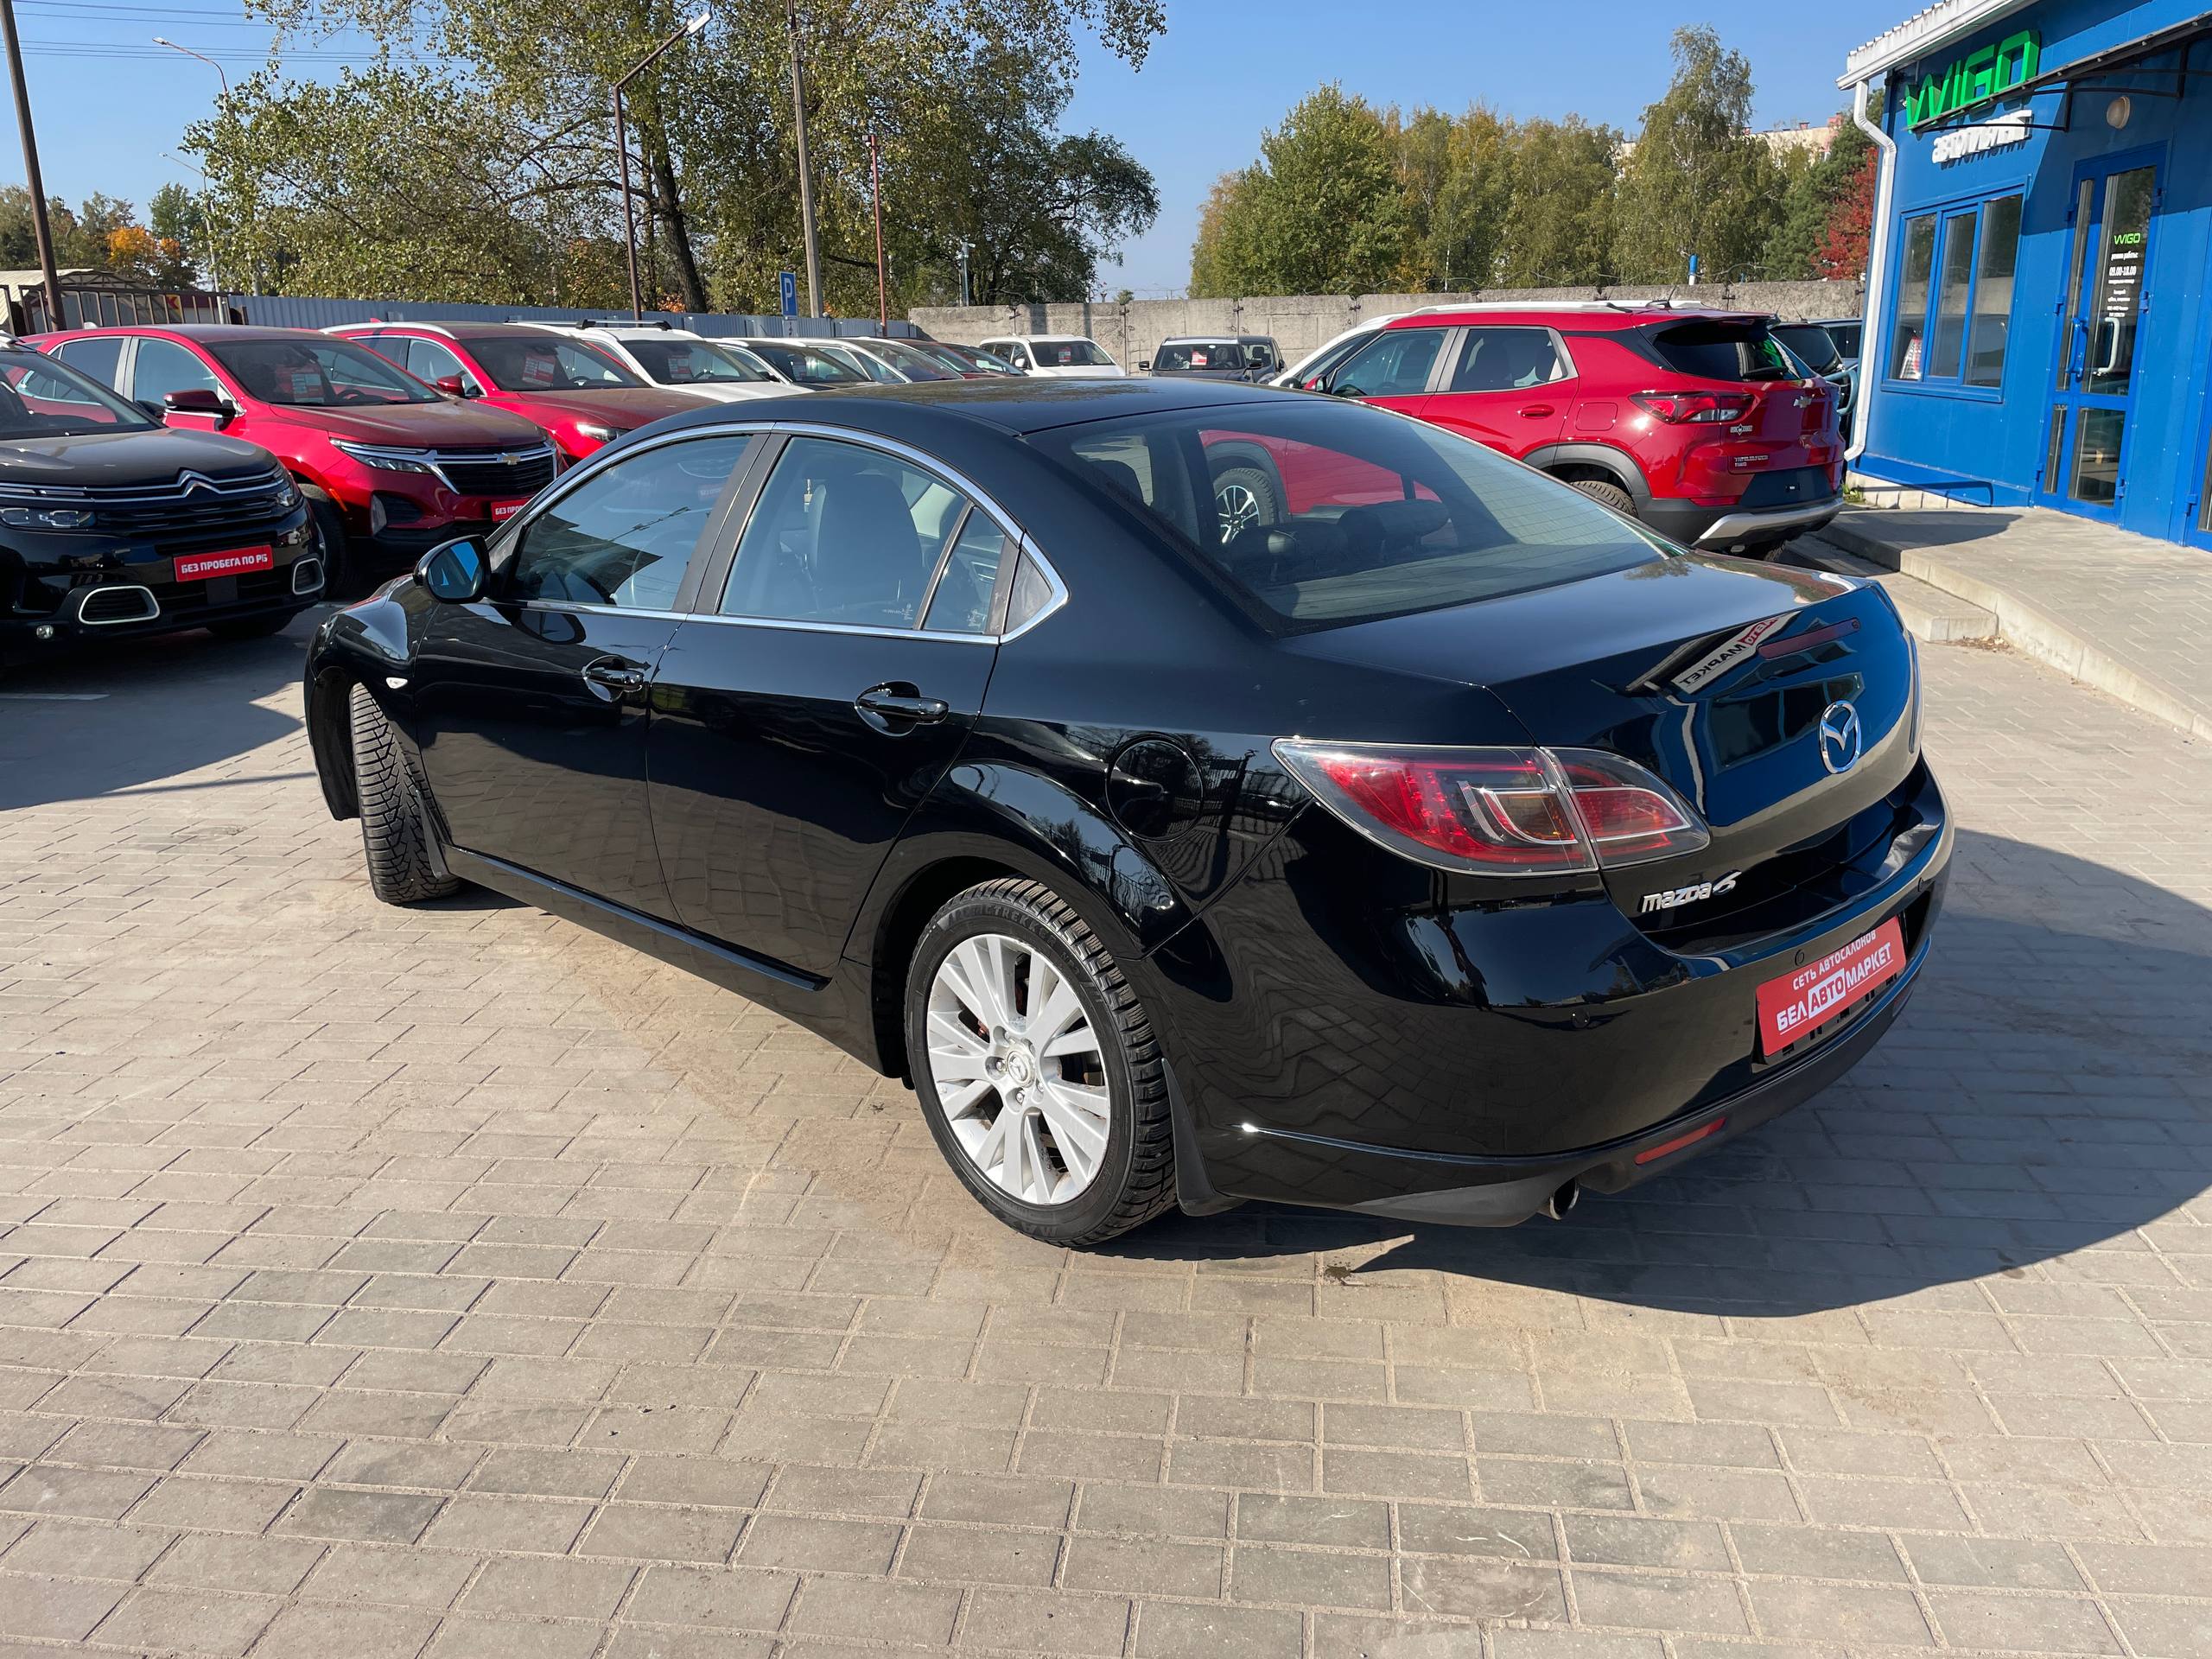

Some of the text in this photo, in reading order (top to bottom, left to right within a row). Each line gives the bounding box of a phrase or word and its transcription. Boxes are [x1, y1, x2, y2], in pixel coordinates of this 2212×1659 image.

[1905, 30, 2040, 134] WIGO
[2113, 232, 2141, 245] WIGO
[784, 277, 793, 312] P
[181, 554, 268, 574] БЕЗ ПРОБЕГА ПО РБ
[1792, 930, 1877, 990] СЕТЬ АВТОСАЛОНОВ
